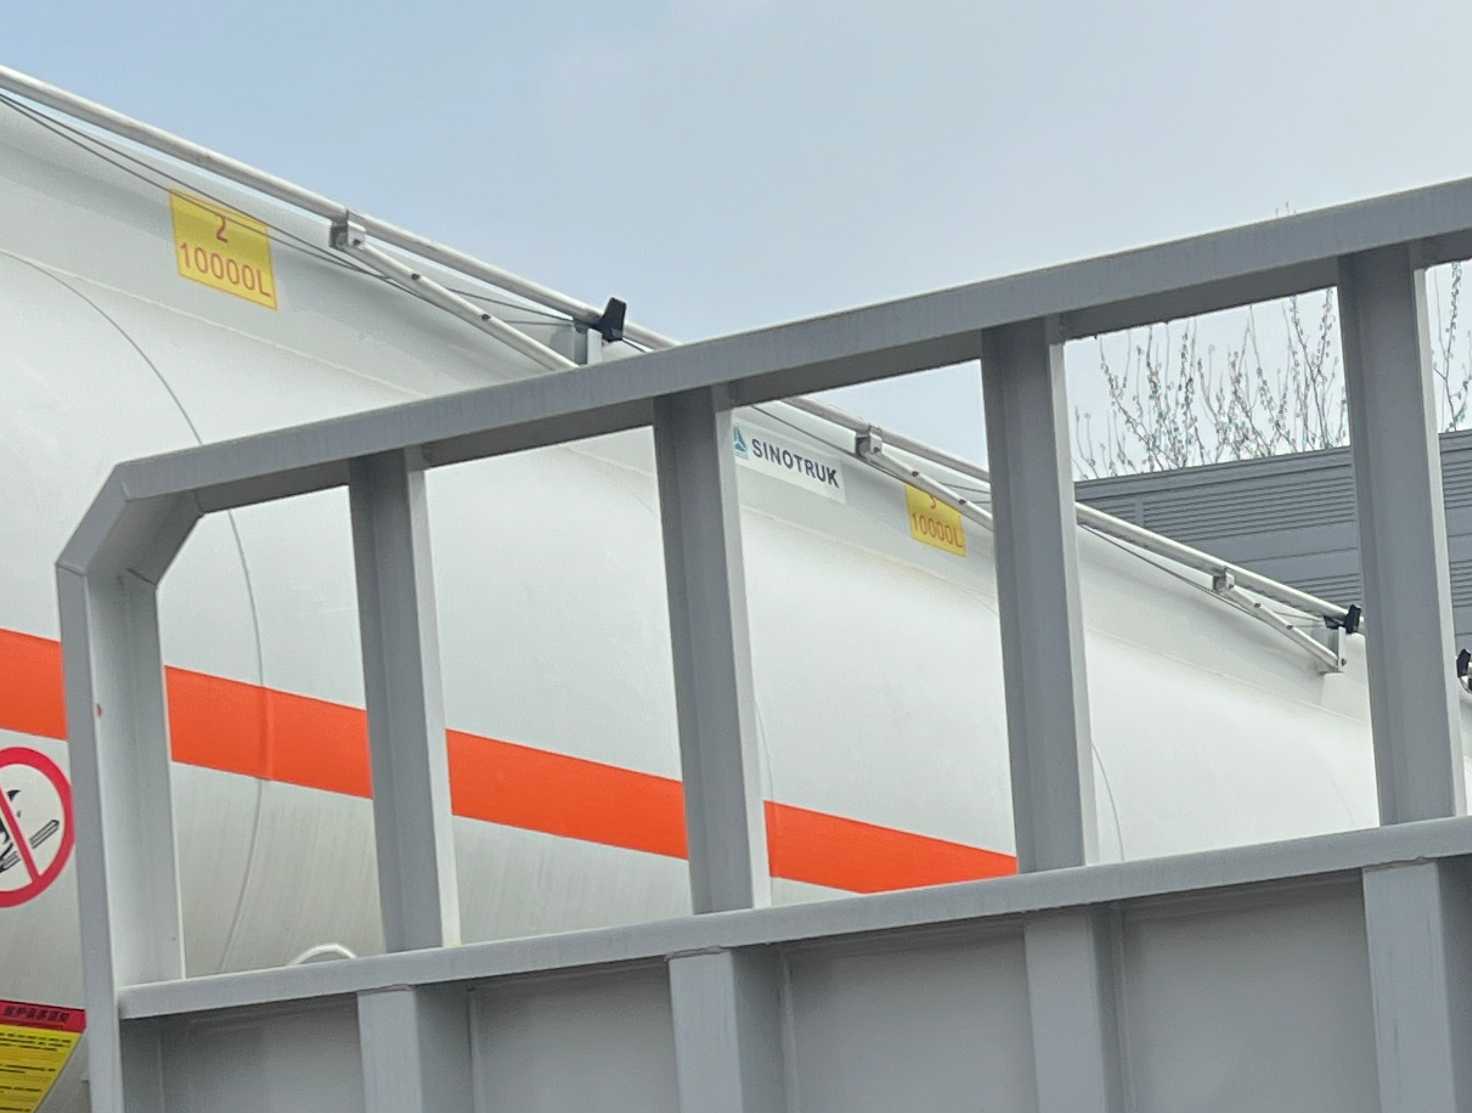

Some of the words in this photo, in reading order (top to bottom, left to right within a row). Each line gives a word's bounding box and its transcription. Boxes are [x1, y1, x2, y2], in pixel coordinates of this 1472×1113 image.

[216, 214, 228, 243] 2
[180, 241, 272, 298] 10000L
[751, 438, 840, 489] SINOTRUK
[911, 511, 964, 549] 10000L
